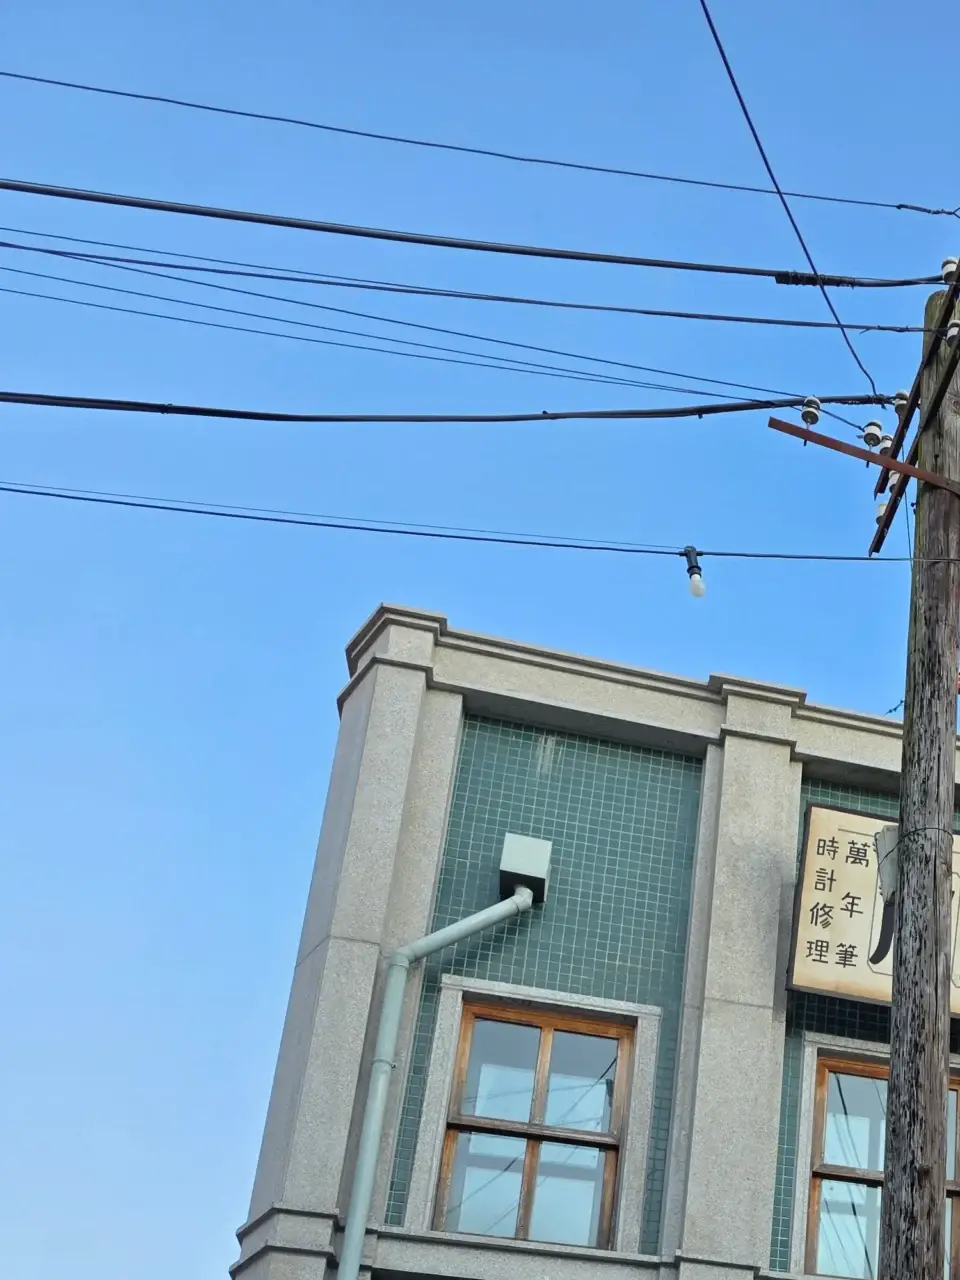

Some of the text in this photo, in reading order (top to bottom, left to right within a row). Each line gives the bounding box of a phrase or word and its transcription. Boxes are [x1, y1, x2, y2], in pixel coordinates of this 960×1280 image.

[805, 836, 840, 965] 時計修理
[835, 840, 871, 969] 萬年筆
